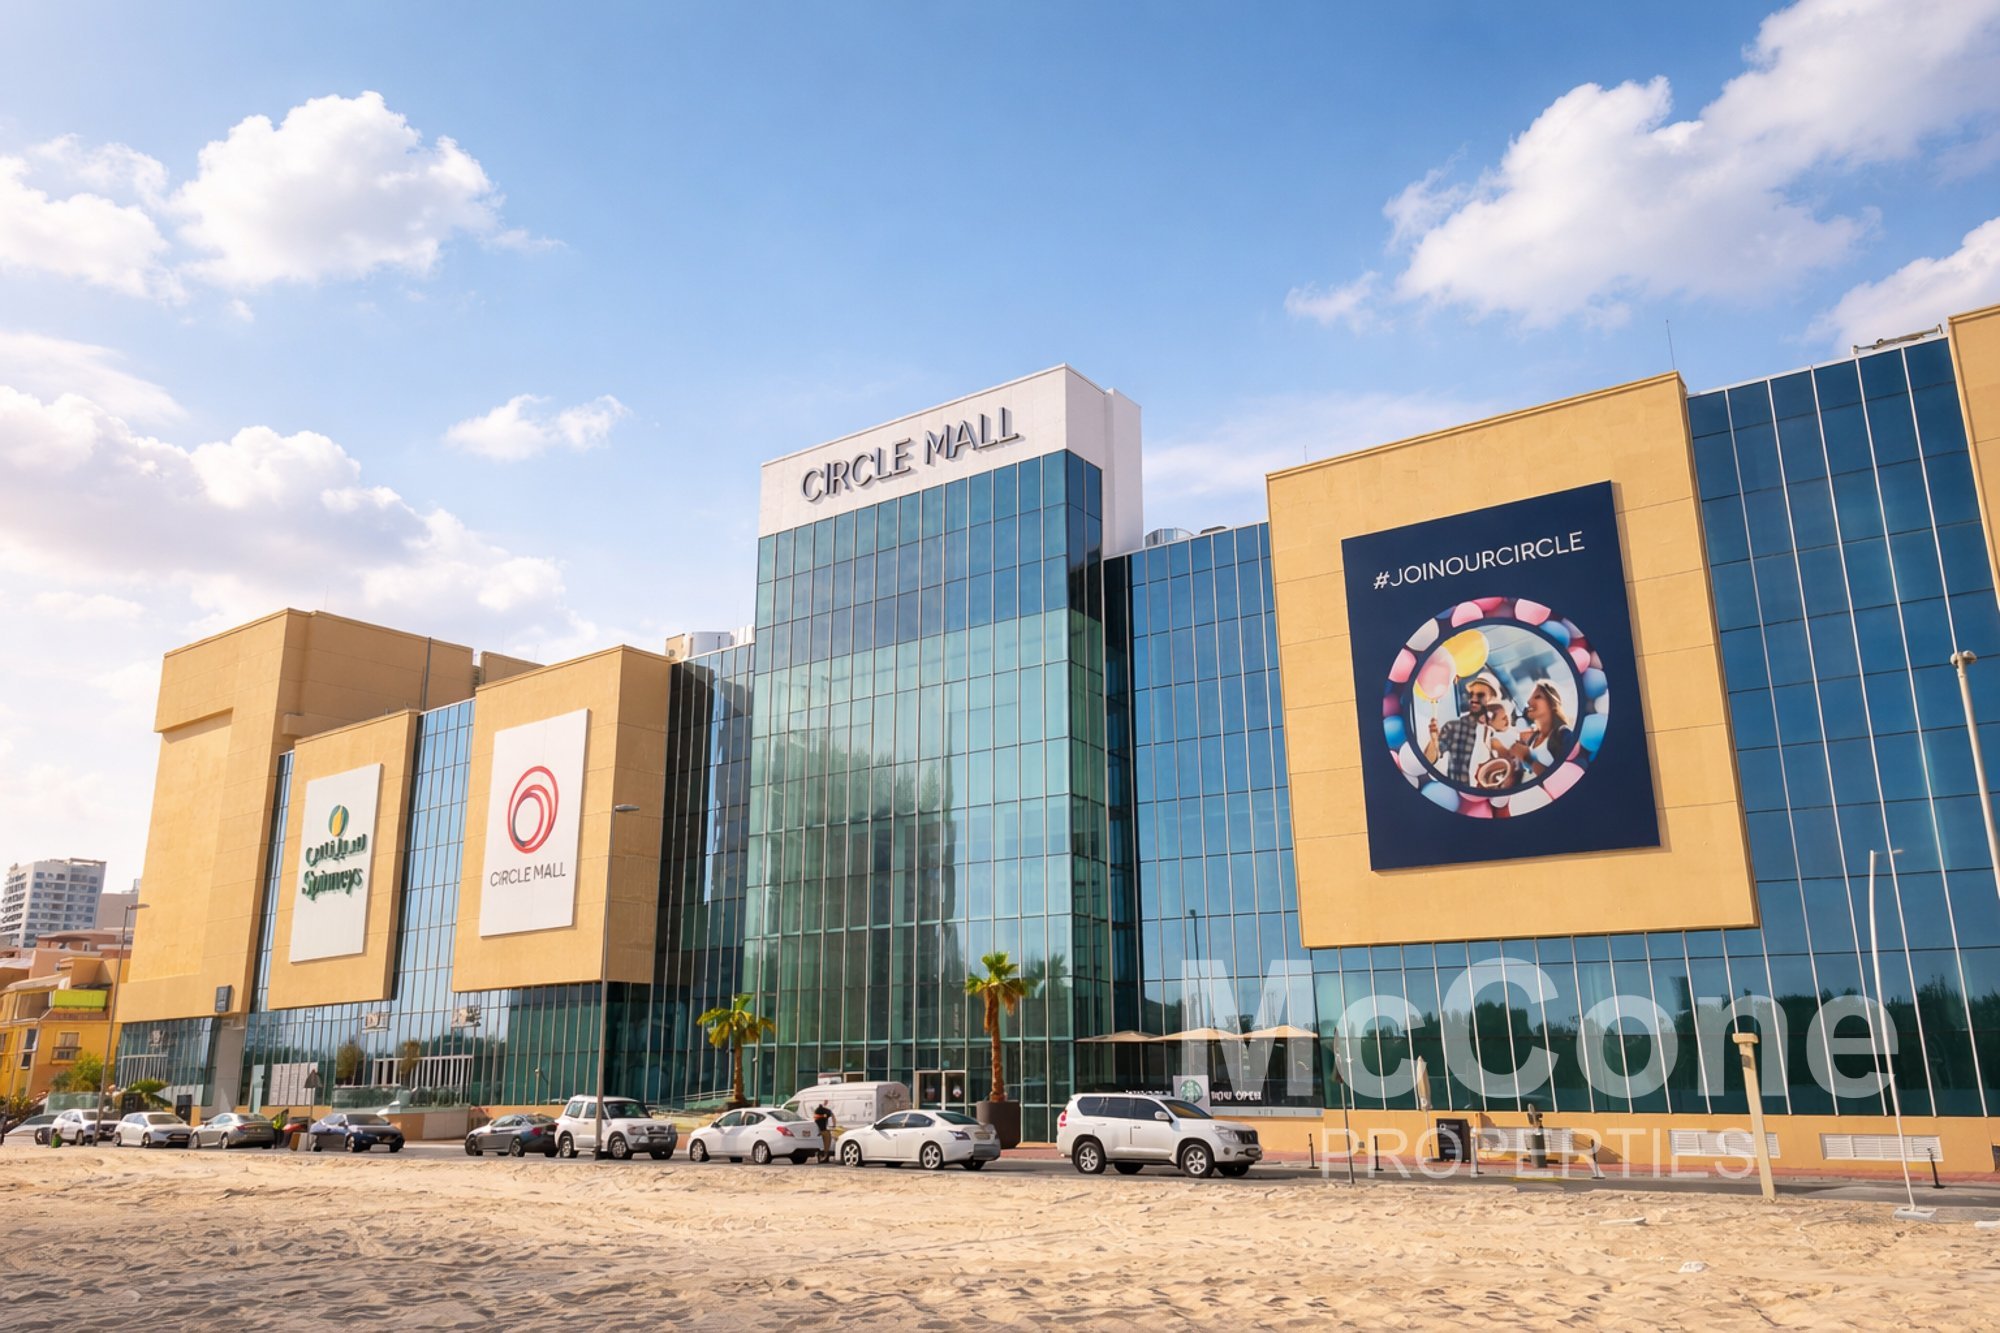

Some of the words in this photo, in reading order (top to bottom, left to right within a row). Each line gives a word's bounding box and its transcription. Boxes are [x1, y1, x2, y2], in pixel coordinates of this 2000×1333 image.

[802, 437, 913, 503] CIRCLE
[924, 406, 1022, 466] MALL
[1373, 530, 1586, 590] #JOINOURCIRCLE
[489, 866, 532, 887] CIRCLE
[534, 861, 566, 880] MALL
